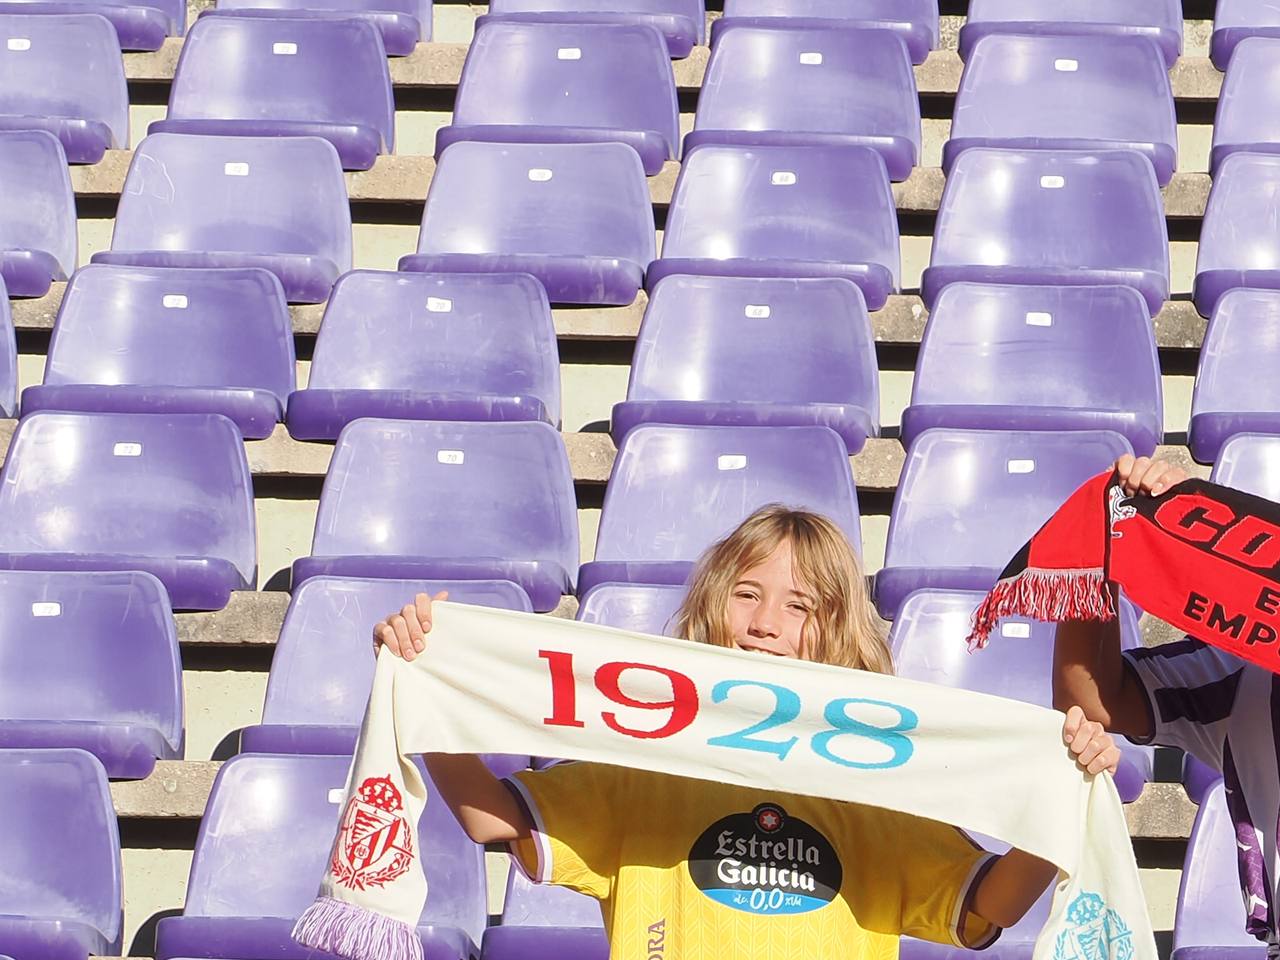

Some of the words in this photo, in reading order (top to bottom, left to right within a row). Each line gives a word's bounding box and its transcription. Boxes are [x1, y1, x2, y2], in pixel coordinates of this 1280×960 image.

[538, 649, 919, 770] 1928
[714, 830, 821, 865] Estrella
[717, 857, 816, 892] Galicia
